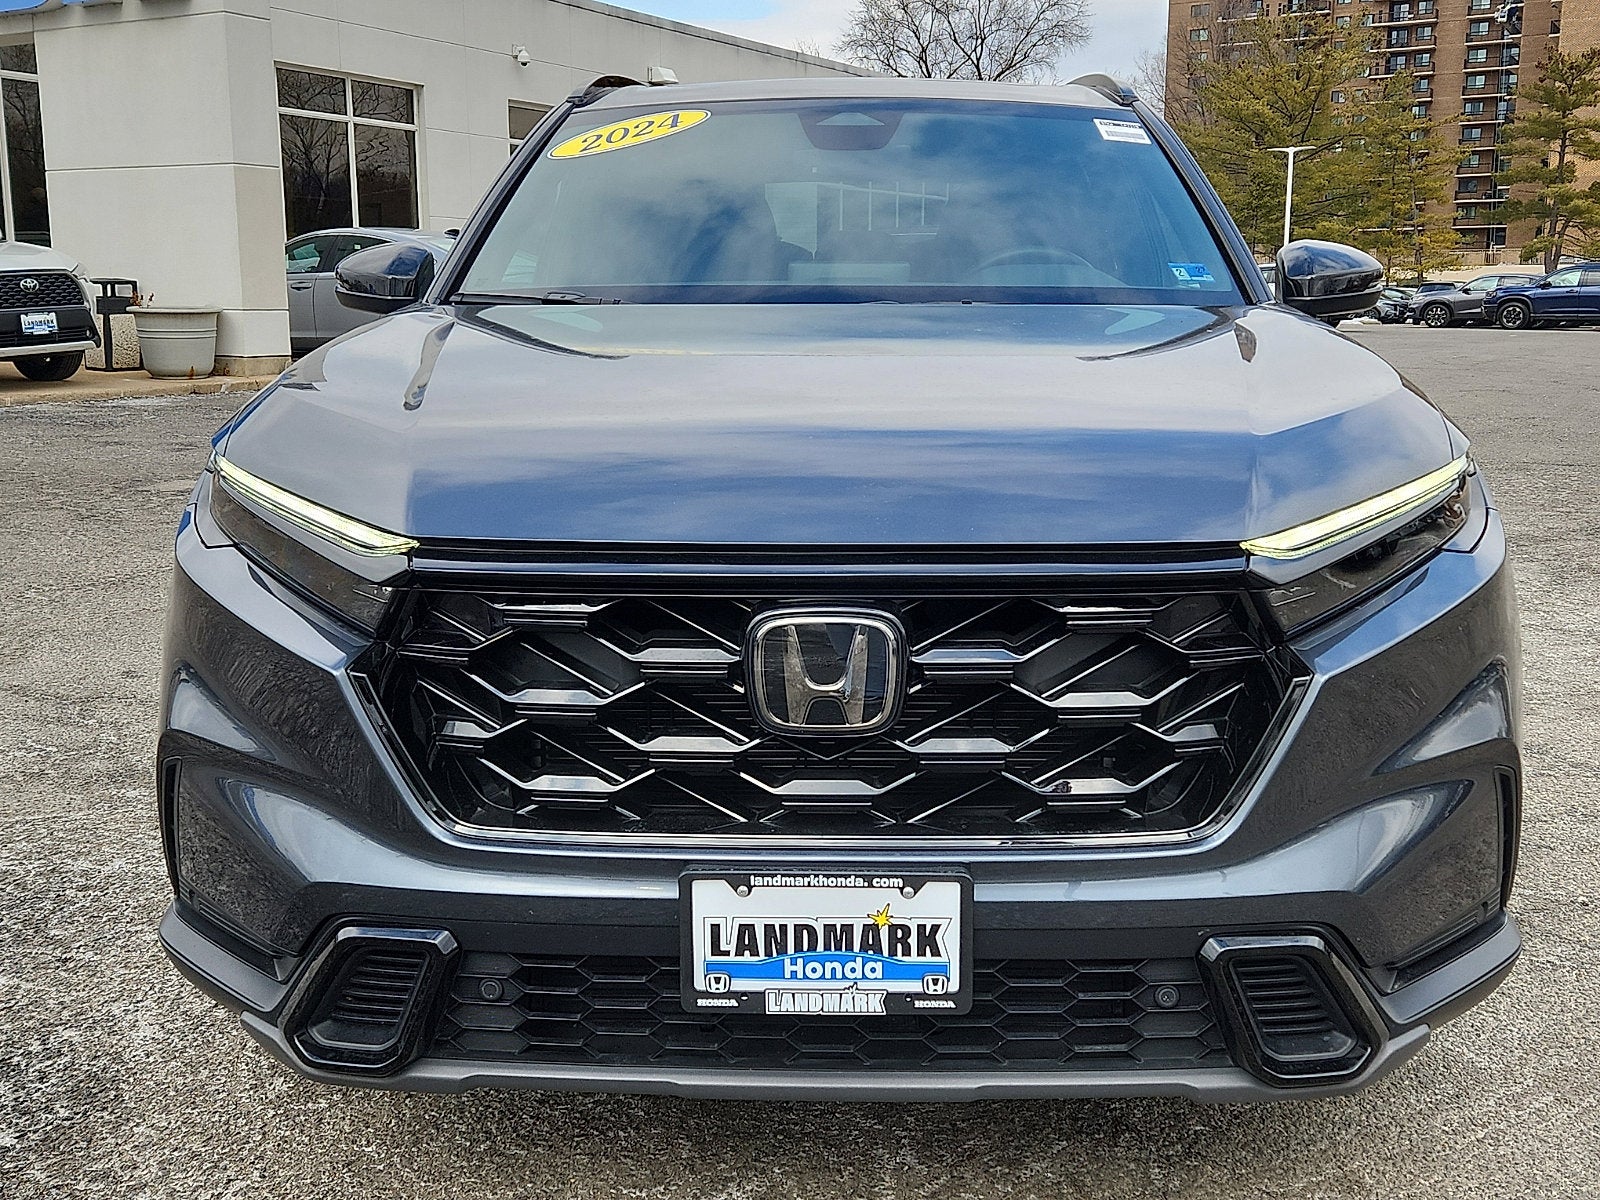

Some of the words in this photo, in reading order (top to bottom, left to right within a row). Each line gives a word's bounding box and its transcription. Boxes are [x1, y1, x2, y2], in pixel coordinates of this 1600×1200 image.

[579, 113, 684, 152] 2024
[1175, 268, 1185, 277] 2
[710, 922, 943, 958] LANDMARK
[784, 957, 883, 980] Honda
[696, 998, 739, 1007] HONDA
[767, 991, 884, 1014] LANDMARK
[914, 1000, 956, 1009] HONDA
